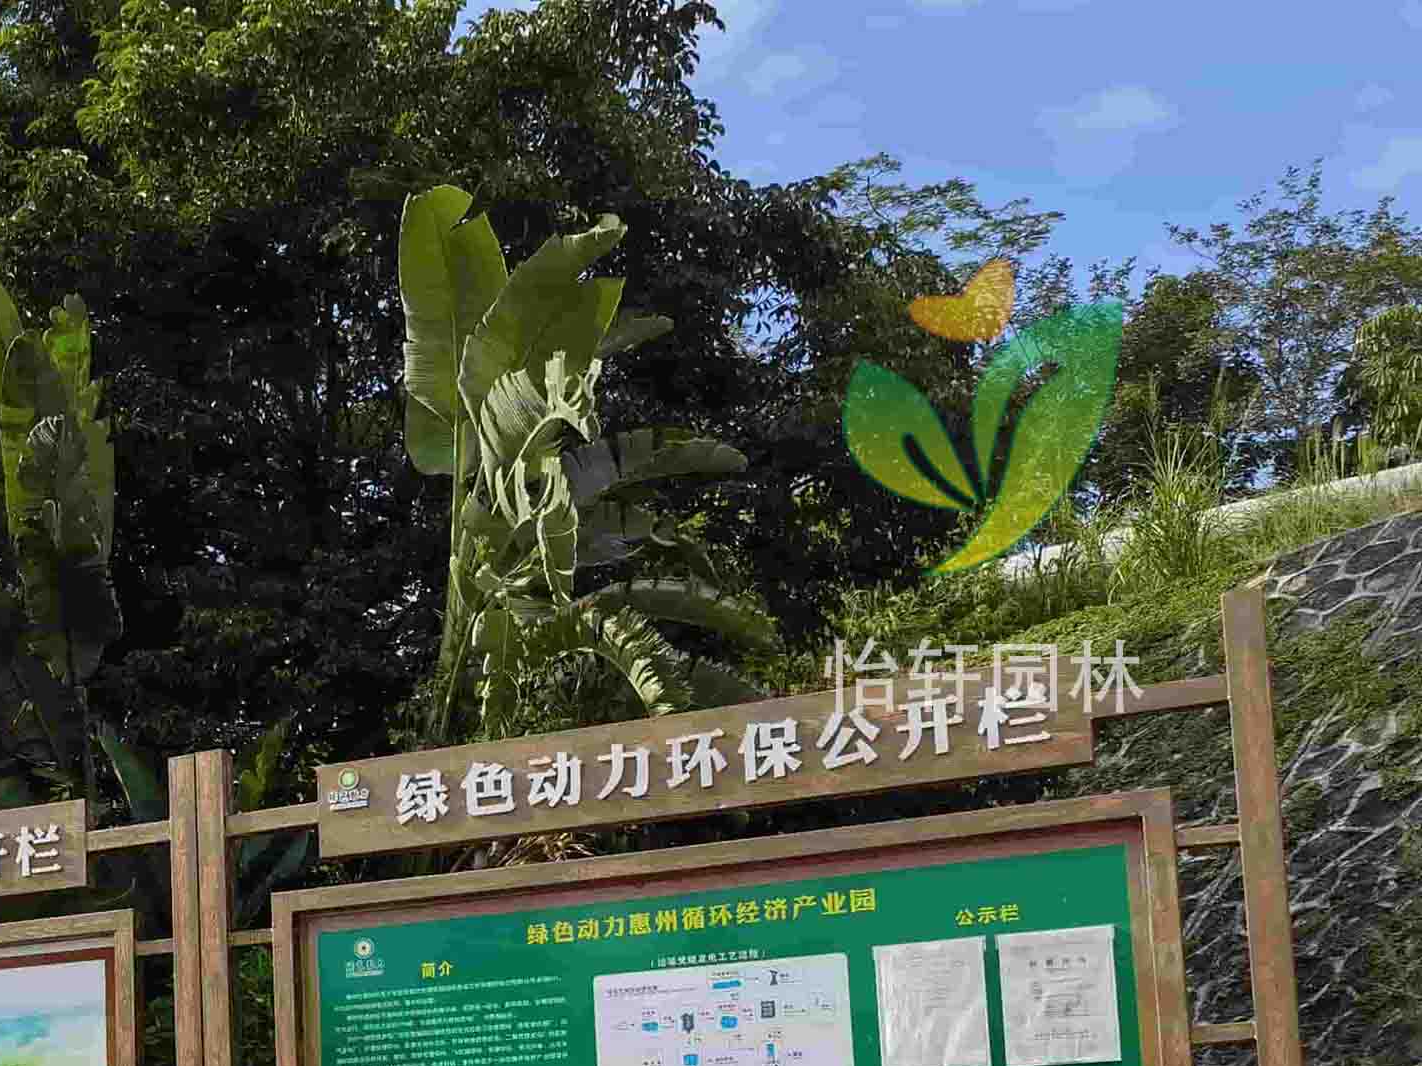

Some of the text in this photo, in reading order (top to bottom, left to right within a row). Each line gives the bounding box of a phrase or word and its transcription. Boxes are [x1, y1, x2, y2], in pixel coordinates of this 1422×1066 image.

[395, 685, 1051, 825] 绿色动力环保公开栏
[527, 887, 876, 945] 绿色动力惠州循环经济产业园
[955, 903, 1020, 926] 公示栏
